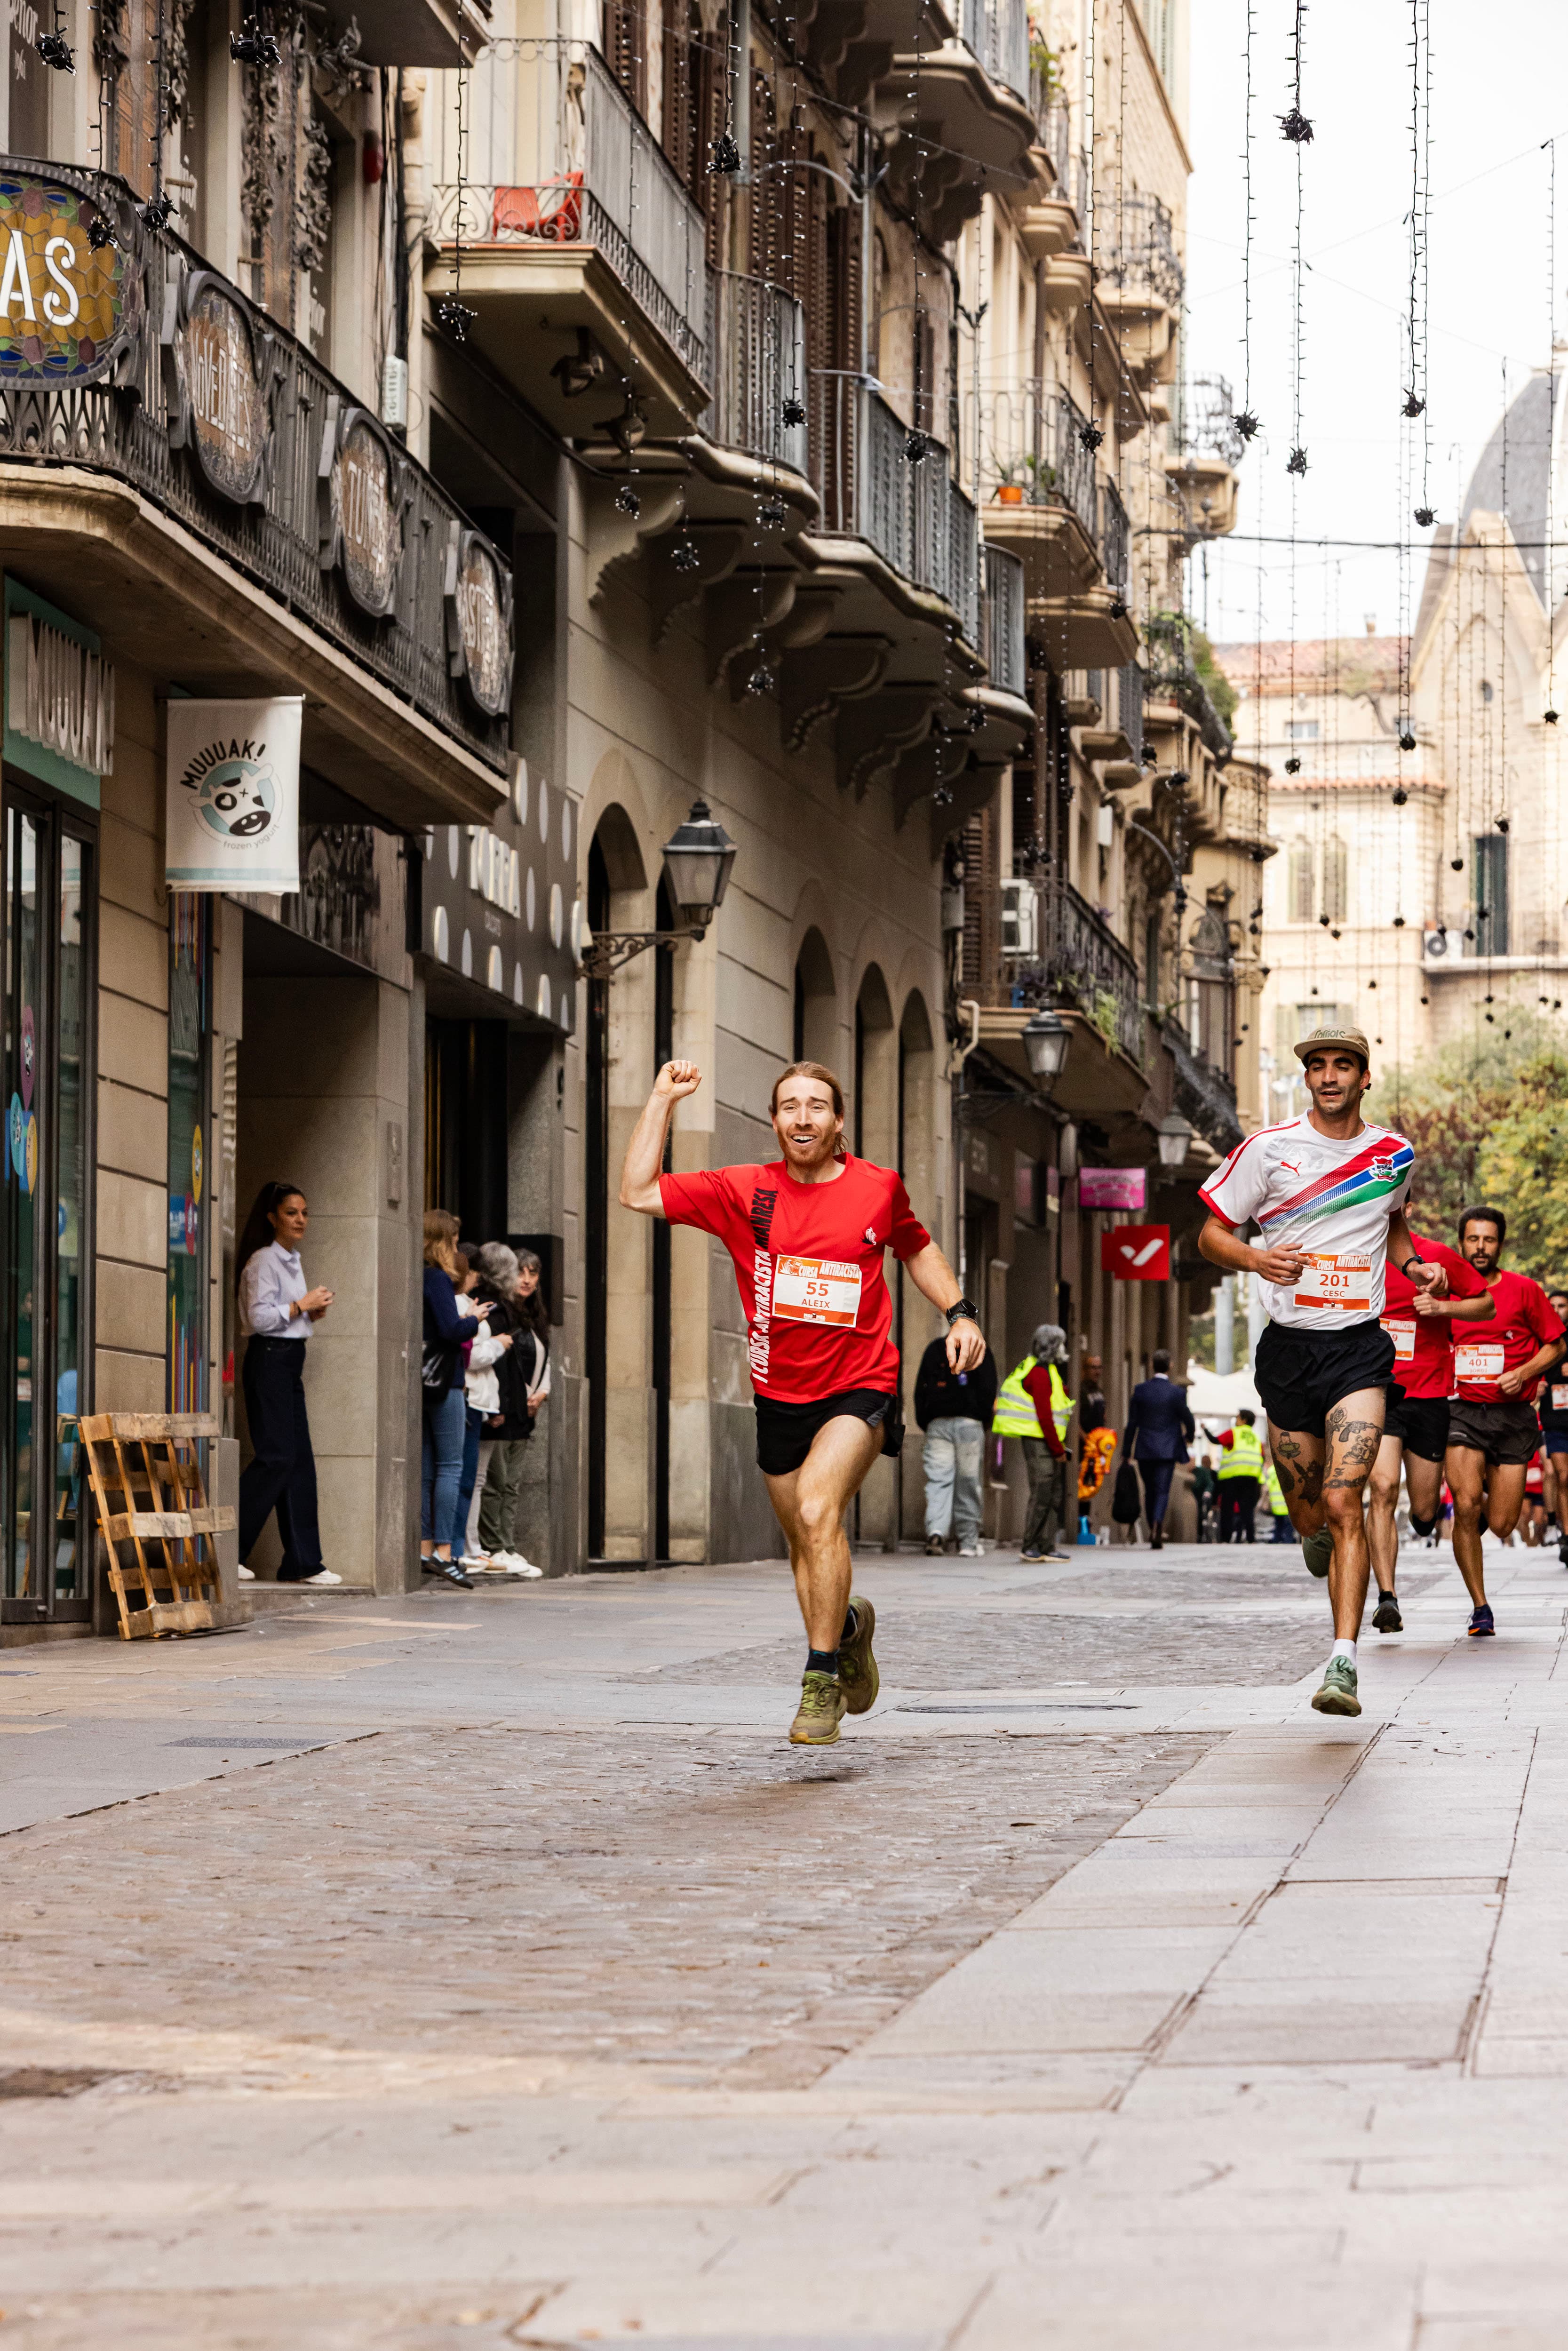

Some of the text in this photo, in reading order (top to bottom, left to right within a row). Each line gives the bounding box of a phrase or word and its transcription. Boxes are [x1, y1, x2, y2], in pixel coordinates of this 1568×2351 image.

[180, 738, 266, 790] MUUUAK!
[223, 824, 280, 850] frozen yogurt
[750, 1187, 778, 1250] MANRESA
[798, 1262, 860, 1279] CURSA ANTIRACISTA
[1317, 1255, 1371, 1271] CURSA ANTIRACISTA
[753, 1249, 772, 1333] ANTIRACISTA
[806, 1281, 829, 1296] 55
[1320, 1274, 1350, 1287] 201
[801, 1298, 830, 1309] ALEIX
[750, 1331, 770, 1375] CURSA
